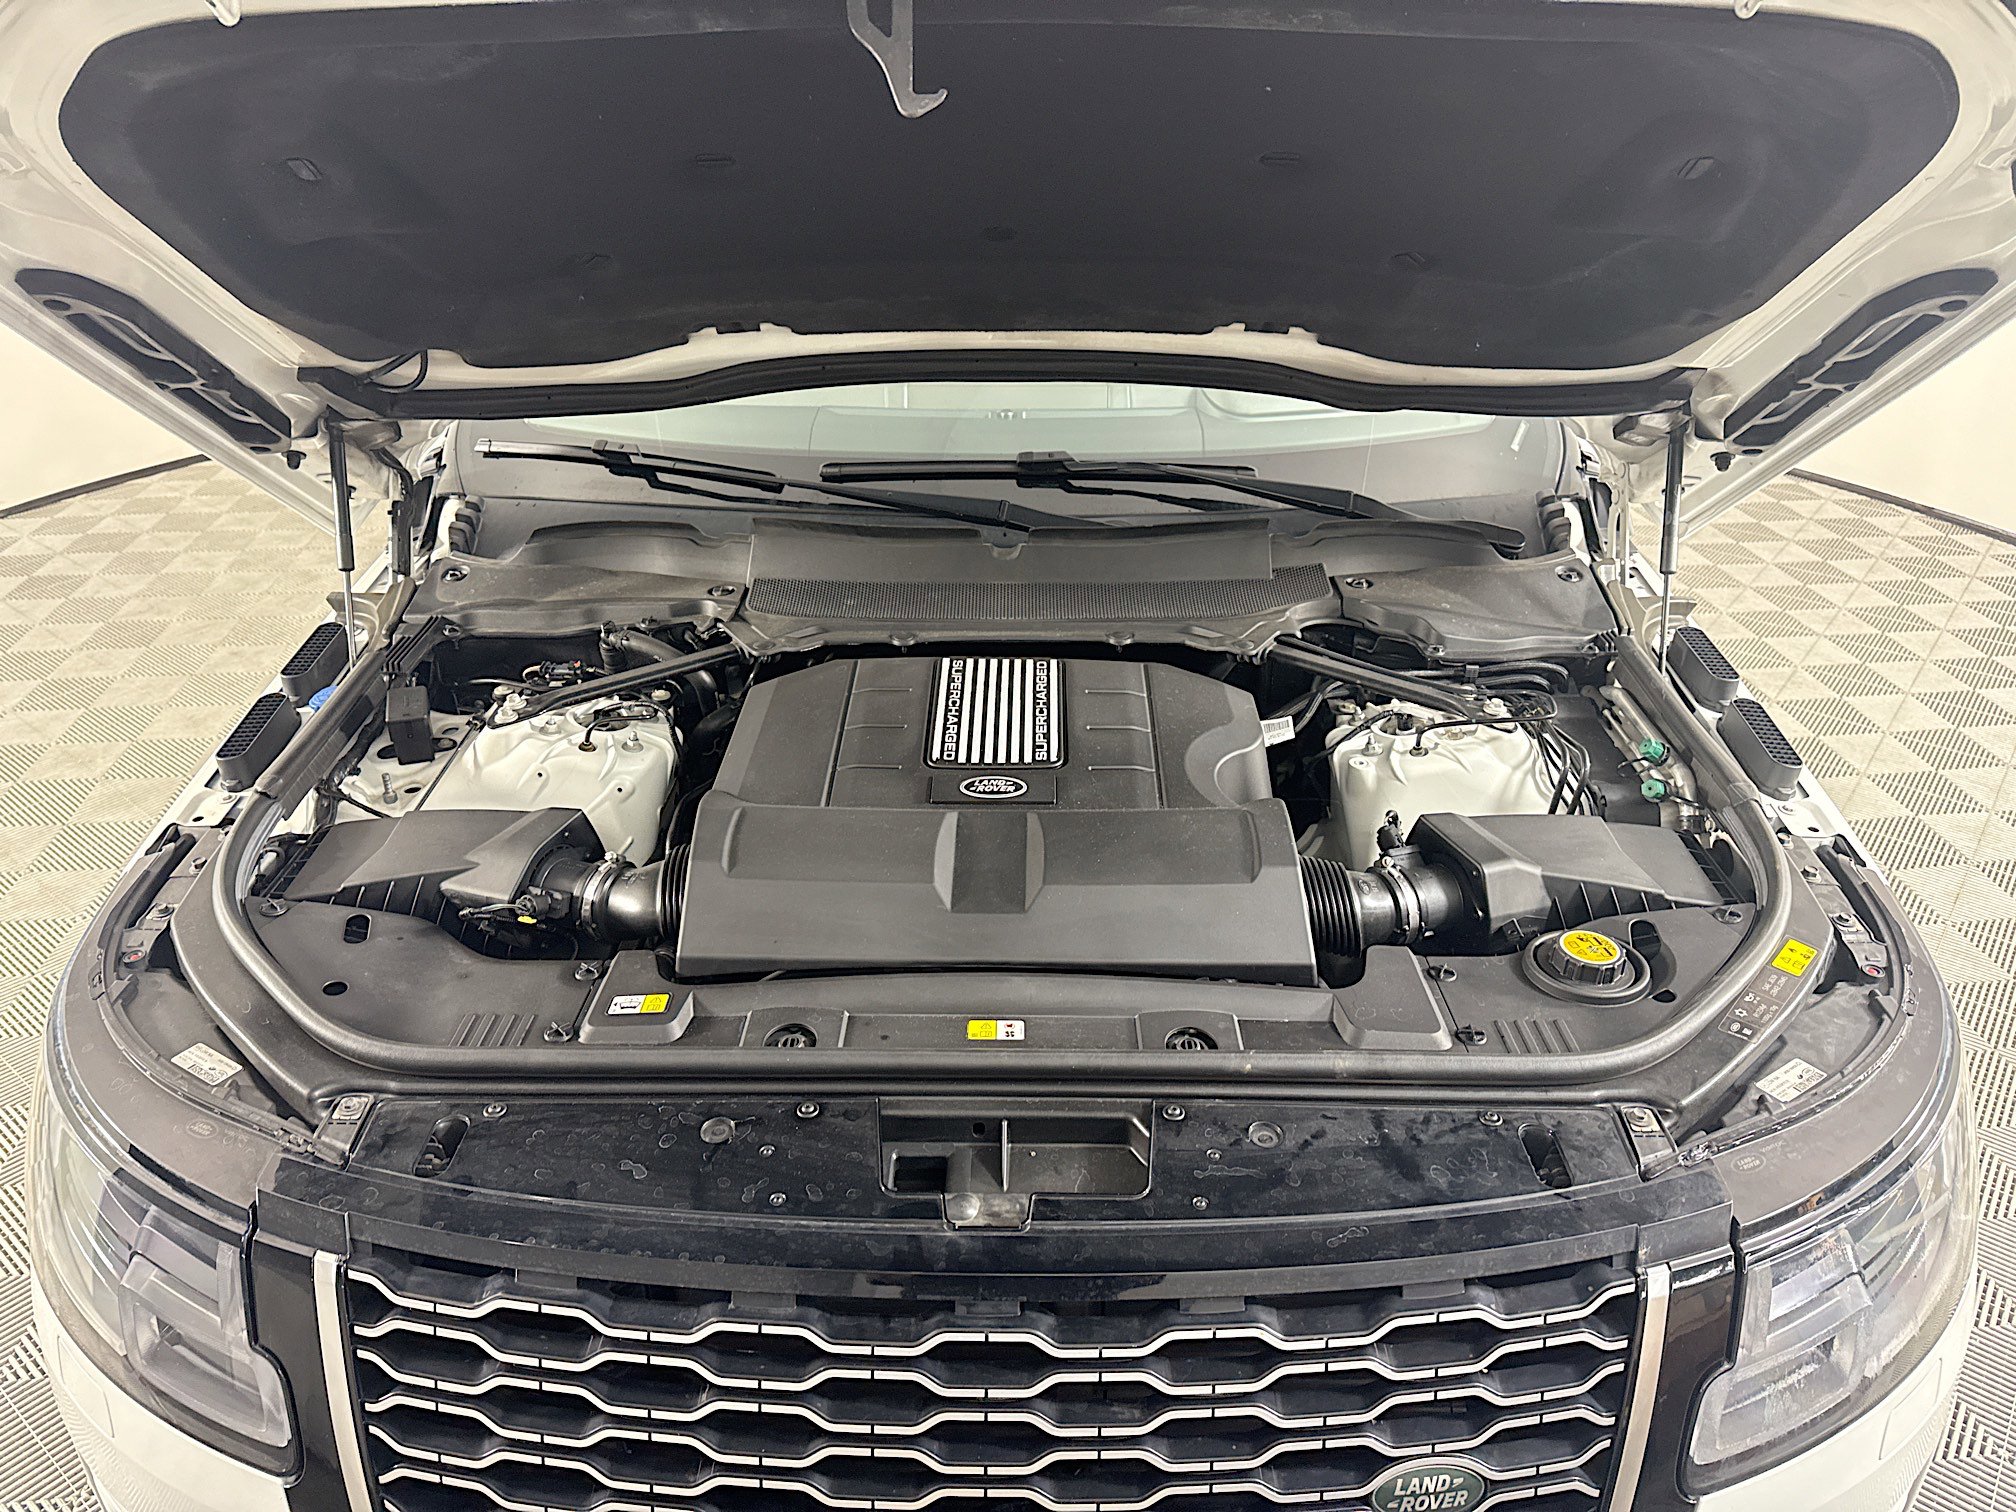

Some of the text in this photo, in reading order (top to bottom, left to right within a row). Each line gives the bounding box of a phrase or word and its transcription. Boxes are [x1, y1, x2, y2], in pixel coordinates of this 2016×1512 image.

[943, 659, 964, 761] SUPERCHARGED
[1035, 661, 1047, 761] SUPERCHARGED
[975, 785, 1016, 793] ROVER
[1394, 1474, 1450, 1496] LAND
[1399, 1490, 1469, 1512] ROVER
